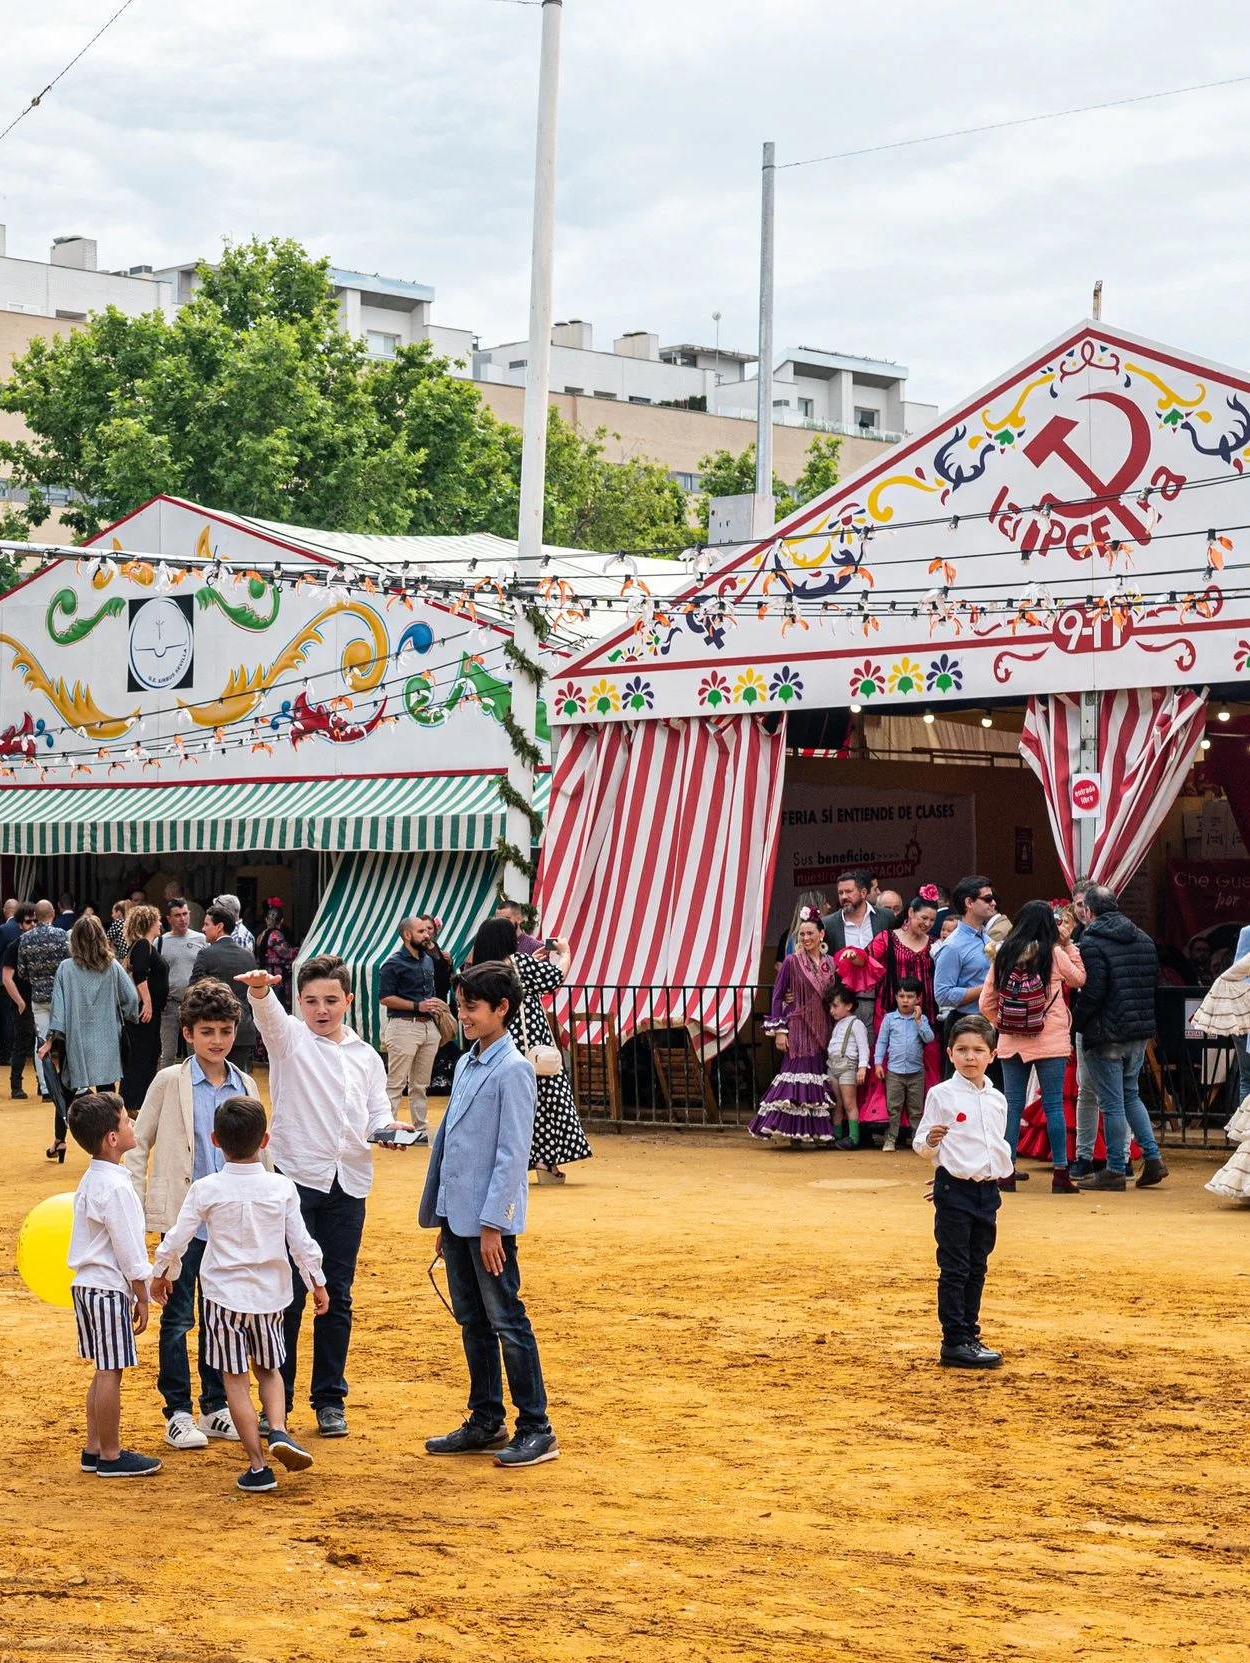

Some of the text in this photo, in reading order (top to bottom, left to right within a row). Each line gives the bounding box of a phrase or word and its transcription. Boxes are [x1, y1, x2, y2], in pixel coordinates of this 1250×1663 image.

[1058, 606, 1122, 651] 9-11
[158, 672, 176, 684] AIRBUS
[175, 648, 188, 674] SEVILLA
[1074, 785, 1096, 798] entrada
[1080, 795, 1094, 805] libre
[782, 803, 955, 826] FERIA SÍ ENTIENDE DE CLASES
[793, 851, 813, 866] Sus
[1174, 871, 1210, 888] Che
[1214, 891, 1241, 911] por
